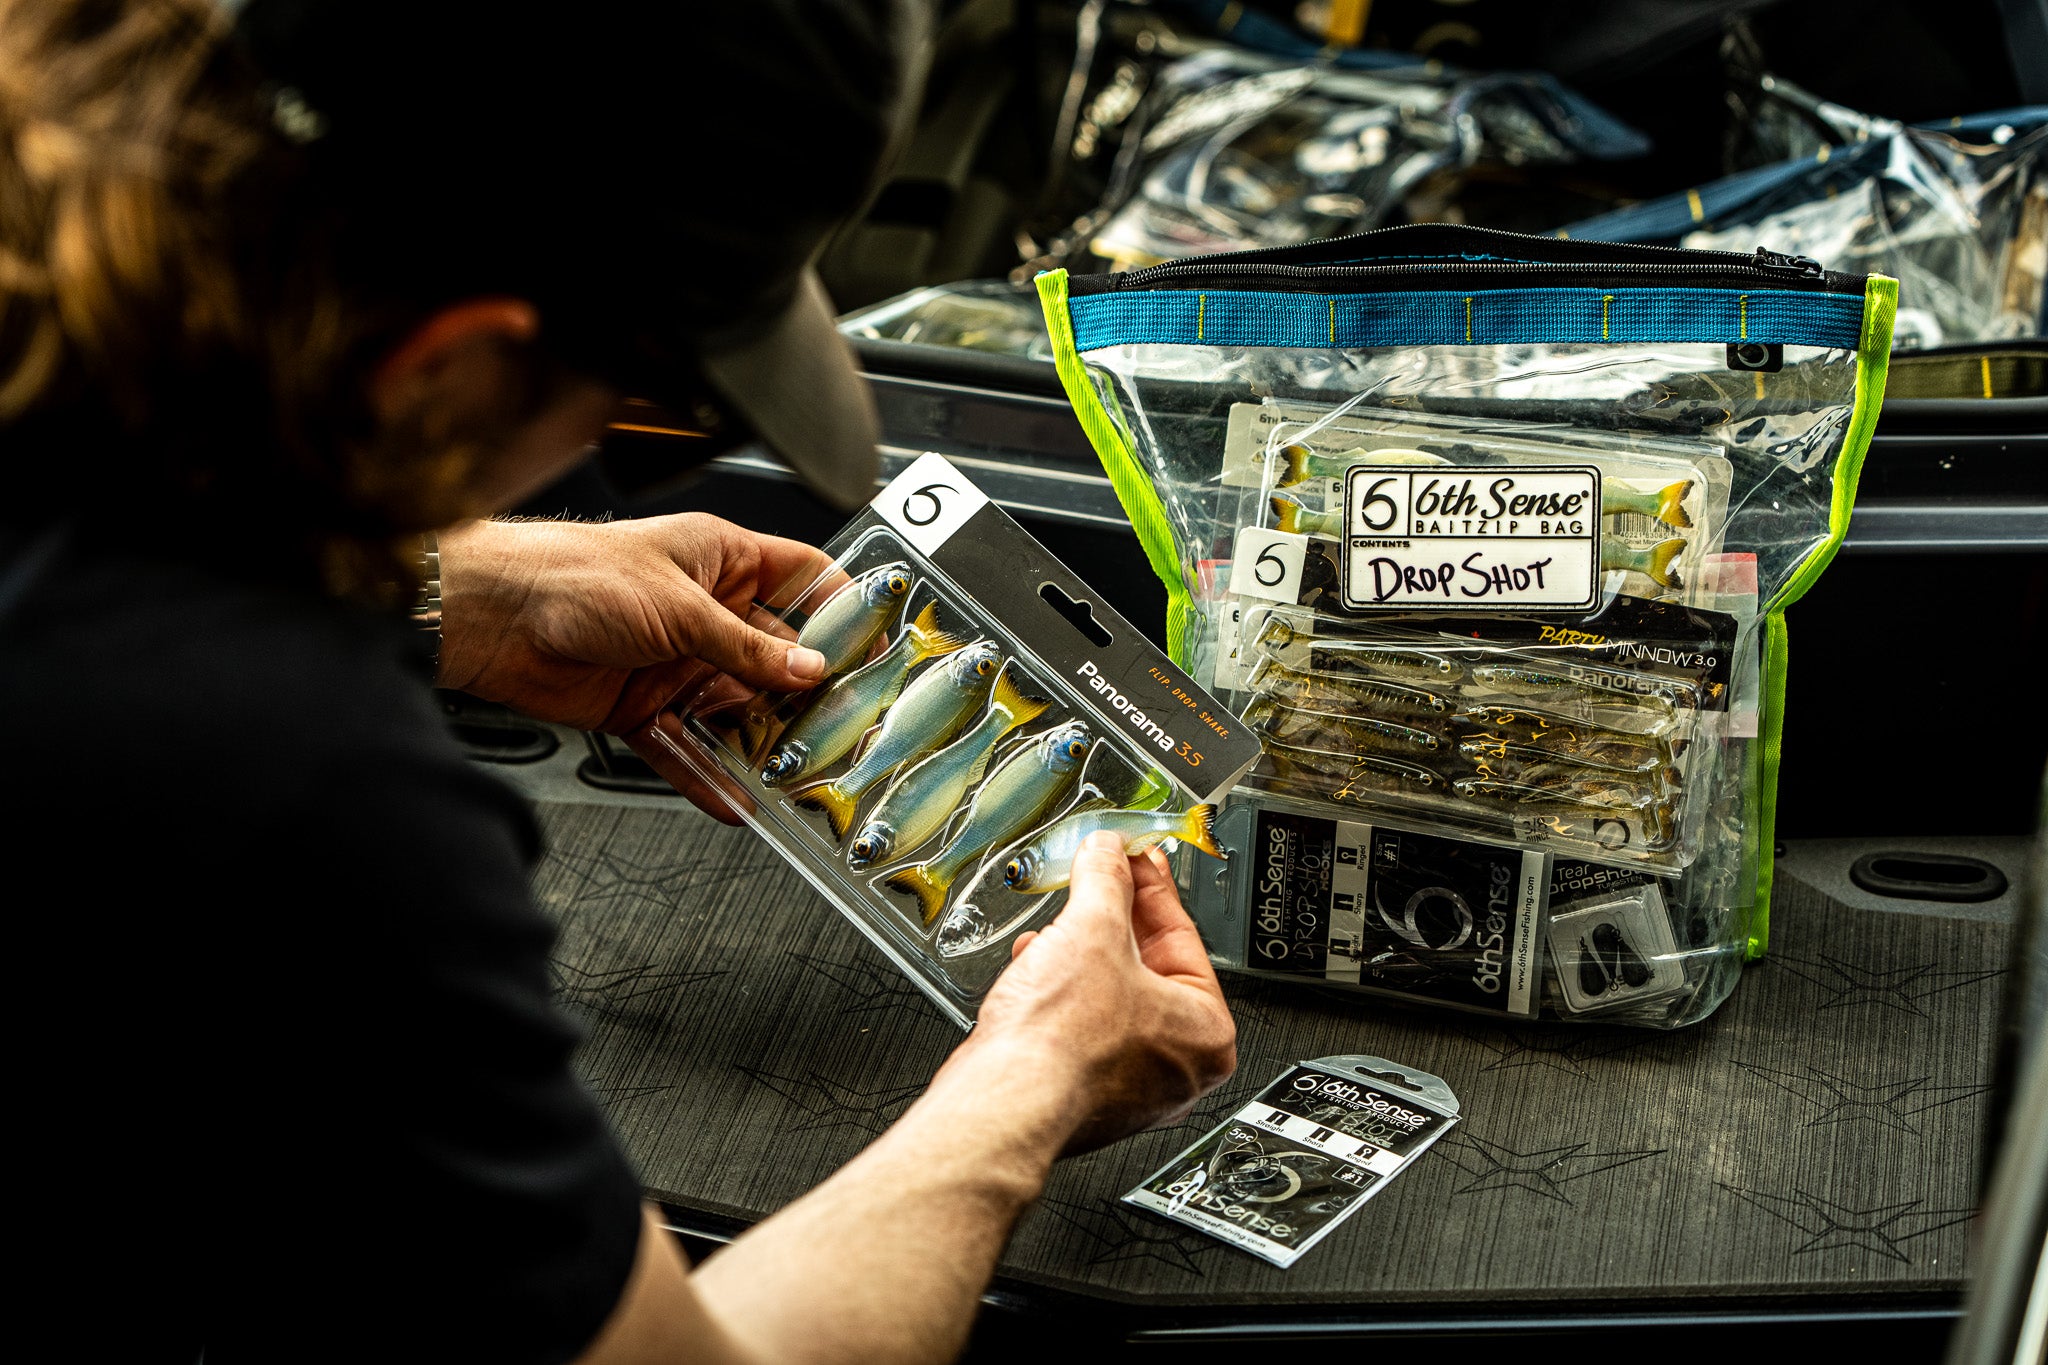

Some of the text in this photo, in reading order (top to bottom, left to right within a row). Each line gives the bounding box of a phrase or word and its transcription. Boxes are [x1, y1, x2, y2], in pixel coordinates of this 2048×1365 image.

[903, 483, 961, 527] 6
[1362, 477, 1398, 531] 6
[1415, 477, 1583, 520] 6th Sense
[1352, 539, 1410, 548] CONTENTS
[1415, 520, 1583, 534] BAITZIP BAG
[1254, 542, 1289, 587] 6
[1368, 552, 1552, 602] DROP SHOT
[1695, 654, 1717, 667] 3.0
[1076, 660, 1204, 767] Panorama 3.5
[1148, 667, 1230, 740] FLIP. DROP. SHAKE.
[1356, 844, 1367, 871] Ringed
[1384, 842, 1398, 862] #1
[1556, 863, 1590, 880] Tear
[1255, 827, 1289, 960] 6 6th Sense
[1283, 831, 1297, 933] FISHING PRODUCTS
[1550, 868, 1642, 895] Dropsho
[1353, 893, 1365, 915] Sharp
[1517, 875, 1535, 992] www.6thSenseFishing.com
[1293, 1074, 1427, 1127] 6 6th Sense
[1316, 1089, 1415, 1132] FISHING PRODUCTS
[1228, 1126, 1255, 1143] 5pc
[1255, 1119, 1372, 1167] Straight Sharp Ringed
[1340, 1171, 1363, 1185] #1
